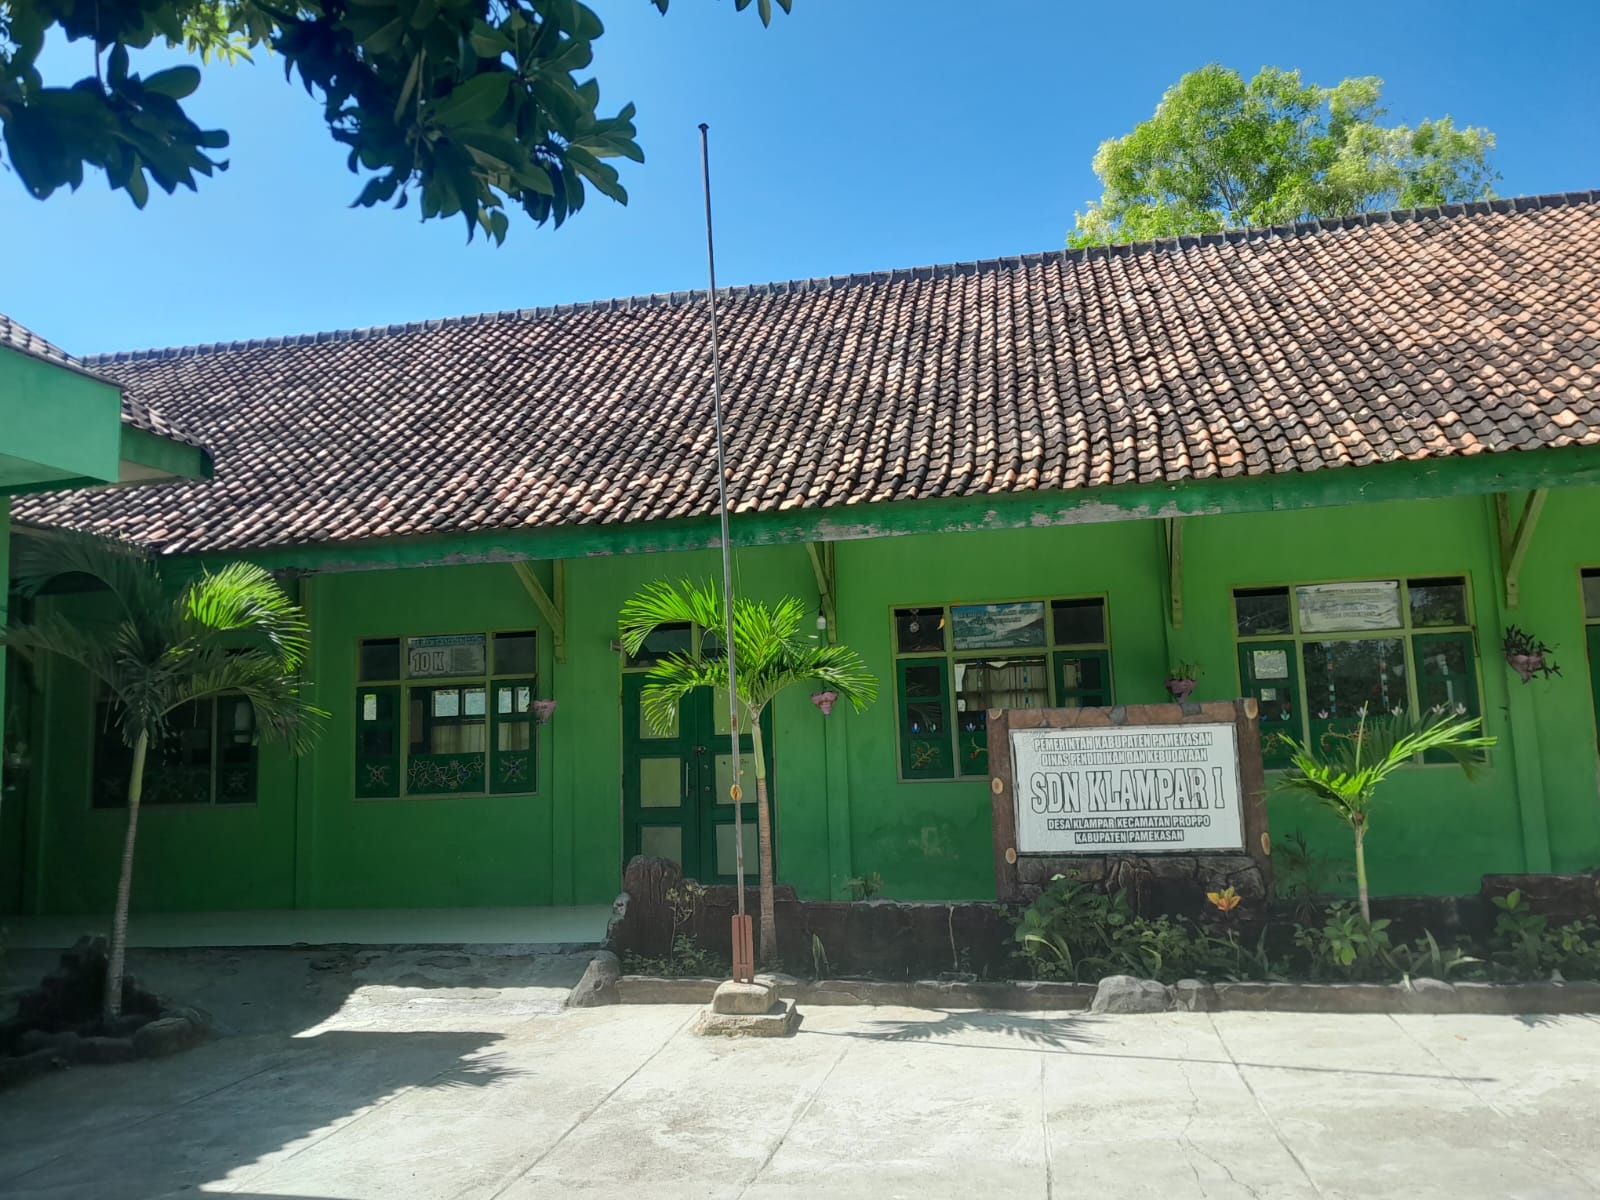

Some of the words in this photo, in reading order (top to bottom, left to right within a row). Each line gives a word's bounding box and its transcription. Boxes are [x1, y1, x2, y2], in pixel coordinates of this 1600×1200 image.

[412, 651, 431, 672] 10
[432, 651, 445, 672] K
[1034, 736, 1094, 752] PEMERINTAH
[1094, 734, 1151, 751] KABUPATEN
[1152, 732, 1212, 748] PAMEKASAN
[1041, 753, 1069, 766] DINAS
[1070, 751, 1126, 765] PENDIDIKAN
[1126, 750, 1146, 764] DAN
[1147, 748, 1208, 763] KEBUDAYAAN
[1031, 771, 1081, 814] SDN
[1086, 767, 1209, 812] KLAMPAR
[1212, 766, 1225, 809] I
[1047, 818, 1072, 831] DESA
[1072, 817, 1115, 830] KLAMPAR
[1115, 816, 1171, 830] KECAMATAN
[1172, 815, 1211, 828] PROPPO
[1075, 831, 1127, 844] KABUPATEN
[1128, 829, 1184, 843] PAMEKASAN
